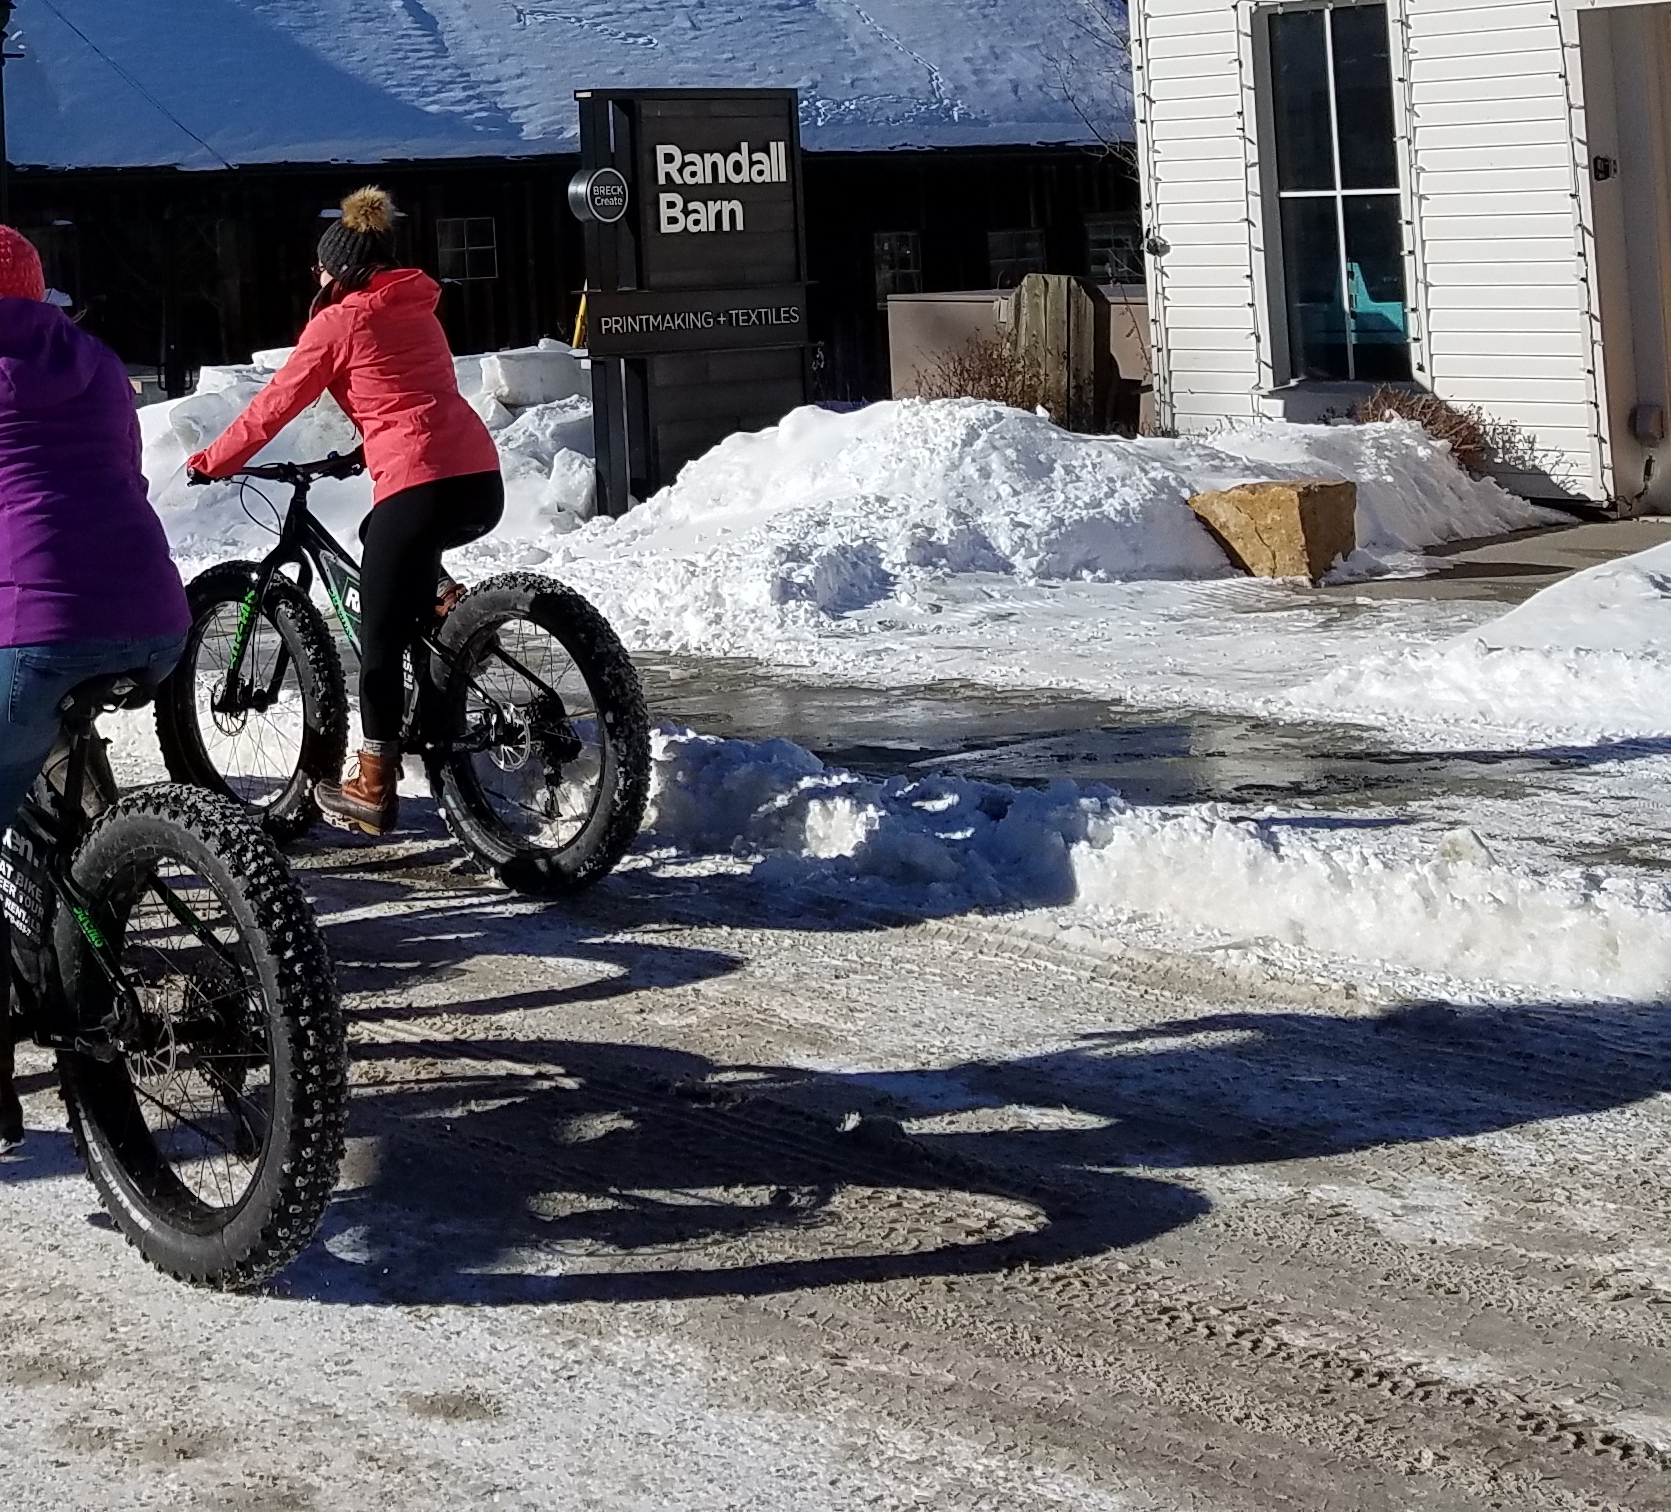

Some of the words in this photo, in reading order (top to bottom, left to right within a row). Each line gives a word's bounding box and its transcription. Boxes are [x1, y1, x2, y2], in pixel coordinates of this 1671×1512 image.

[655, 141, 787, 185] Randall
[593, 185, 624, 196] BRECK
[594, 196, 623, 206] Create
[658, 192, 745, 234] Barn
[601, 311, 714, 335] PRINTMAKING
[729, 306, 800, 327] TEXTILES
[15, 871, 43, 904] BIKE
[18, 890, 45, 920] TOUR
